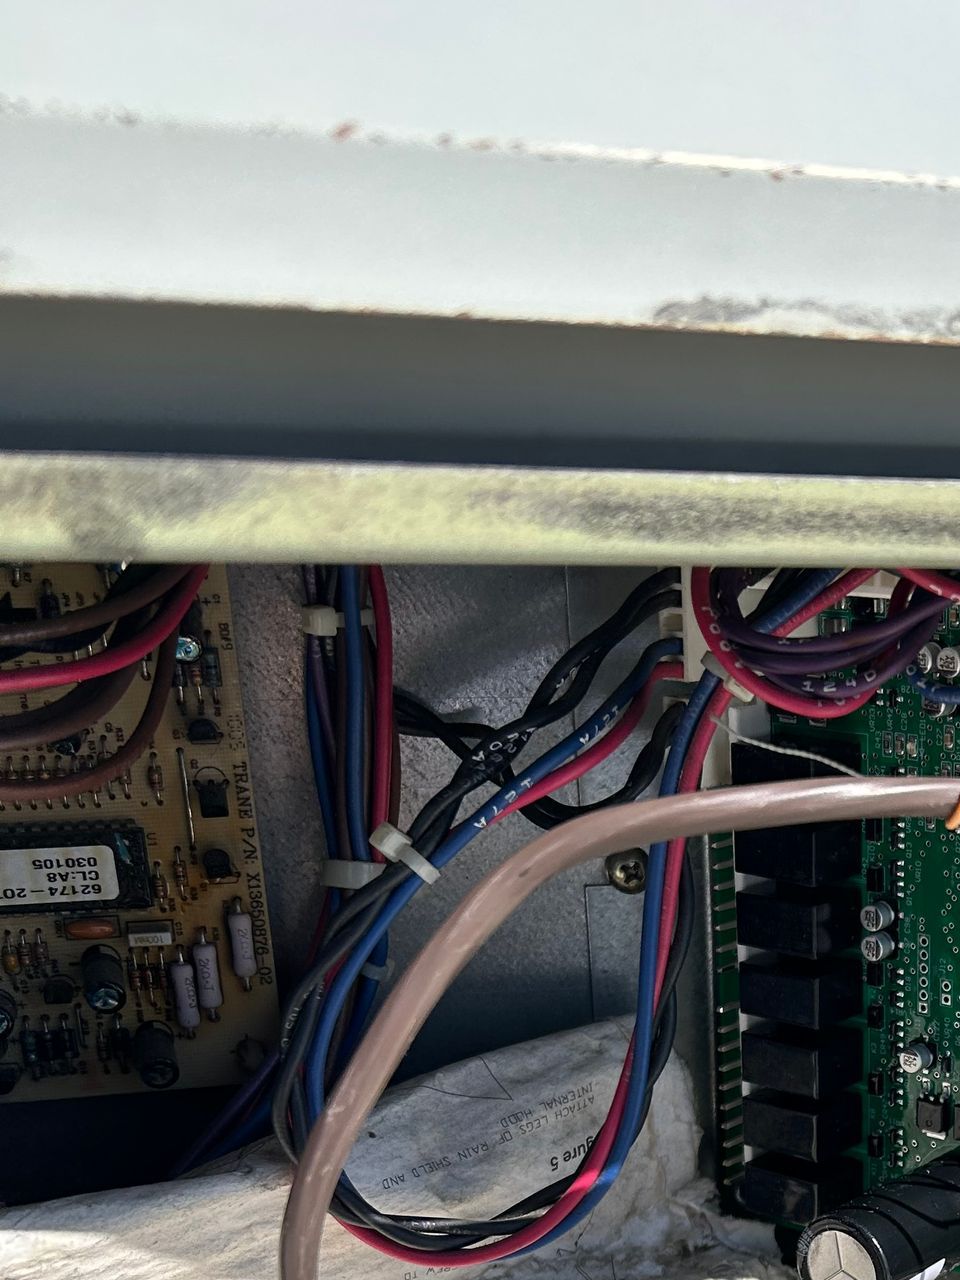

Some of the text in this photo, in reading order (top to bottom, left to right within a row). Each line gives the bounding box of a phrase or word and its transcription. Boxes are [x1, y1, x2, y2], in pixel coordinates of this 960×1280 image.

[32, 856, 98, 870] 030105
[47, 870, 100, 882] CL:A8
[233, 761, 253, 820] TRANE
[246, 872, 272, 985] X13650876-02
[499, 1083, 595, 1128] INTERNAL HOOD
[381, 1095, 595, 1190] ATTACH LEGS OF RAIN SHIELD AND
[549, 1156, 560, 1172] 5
